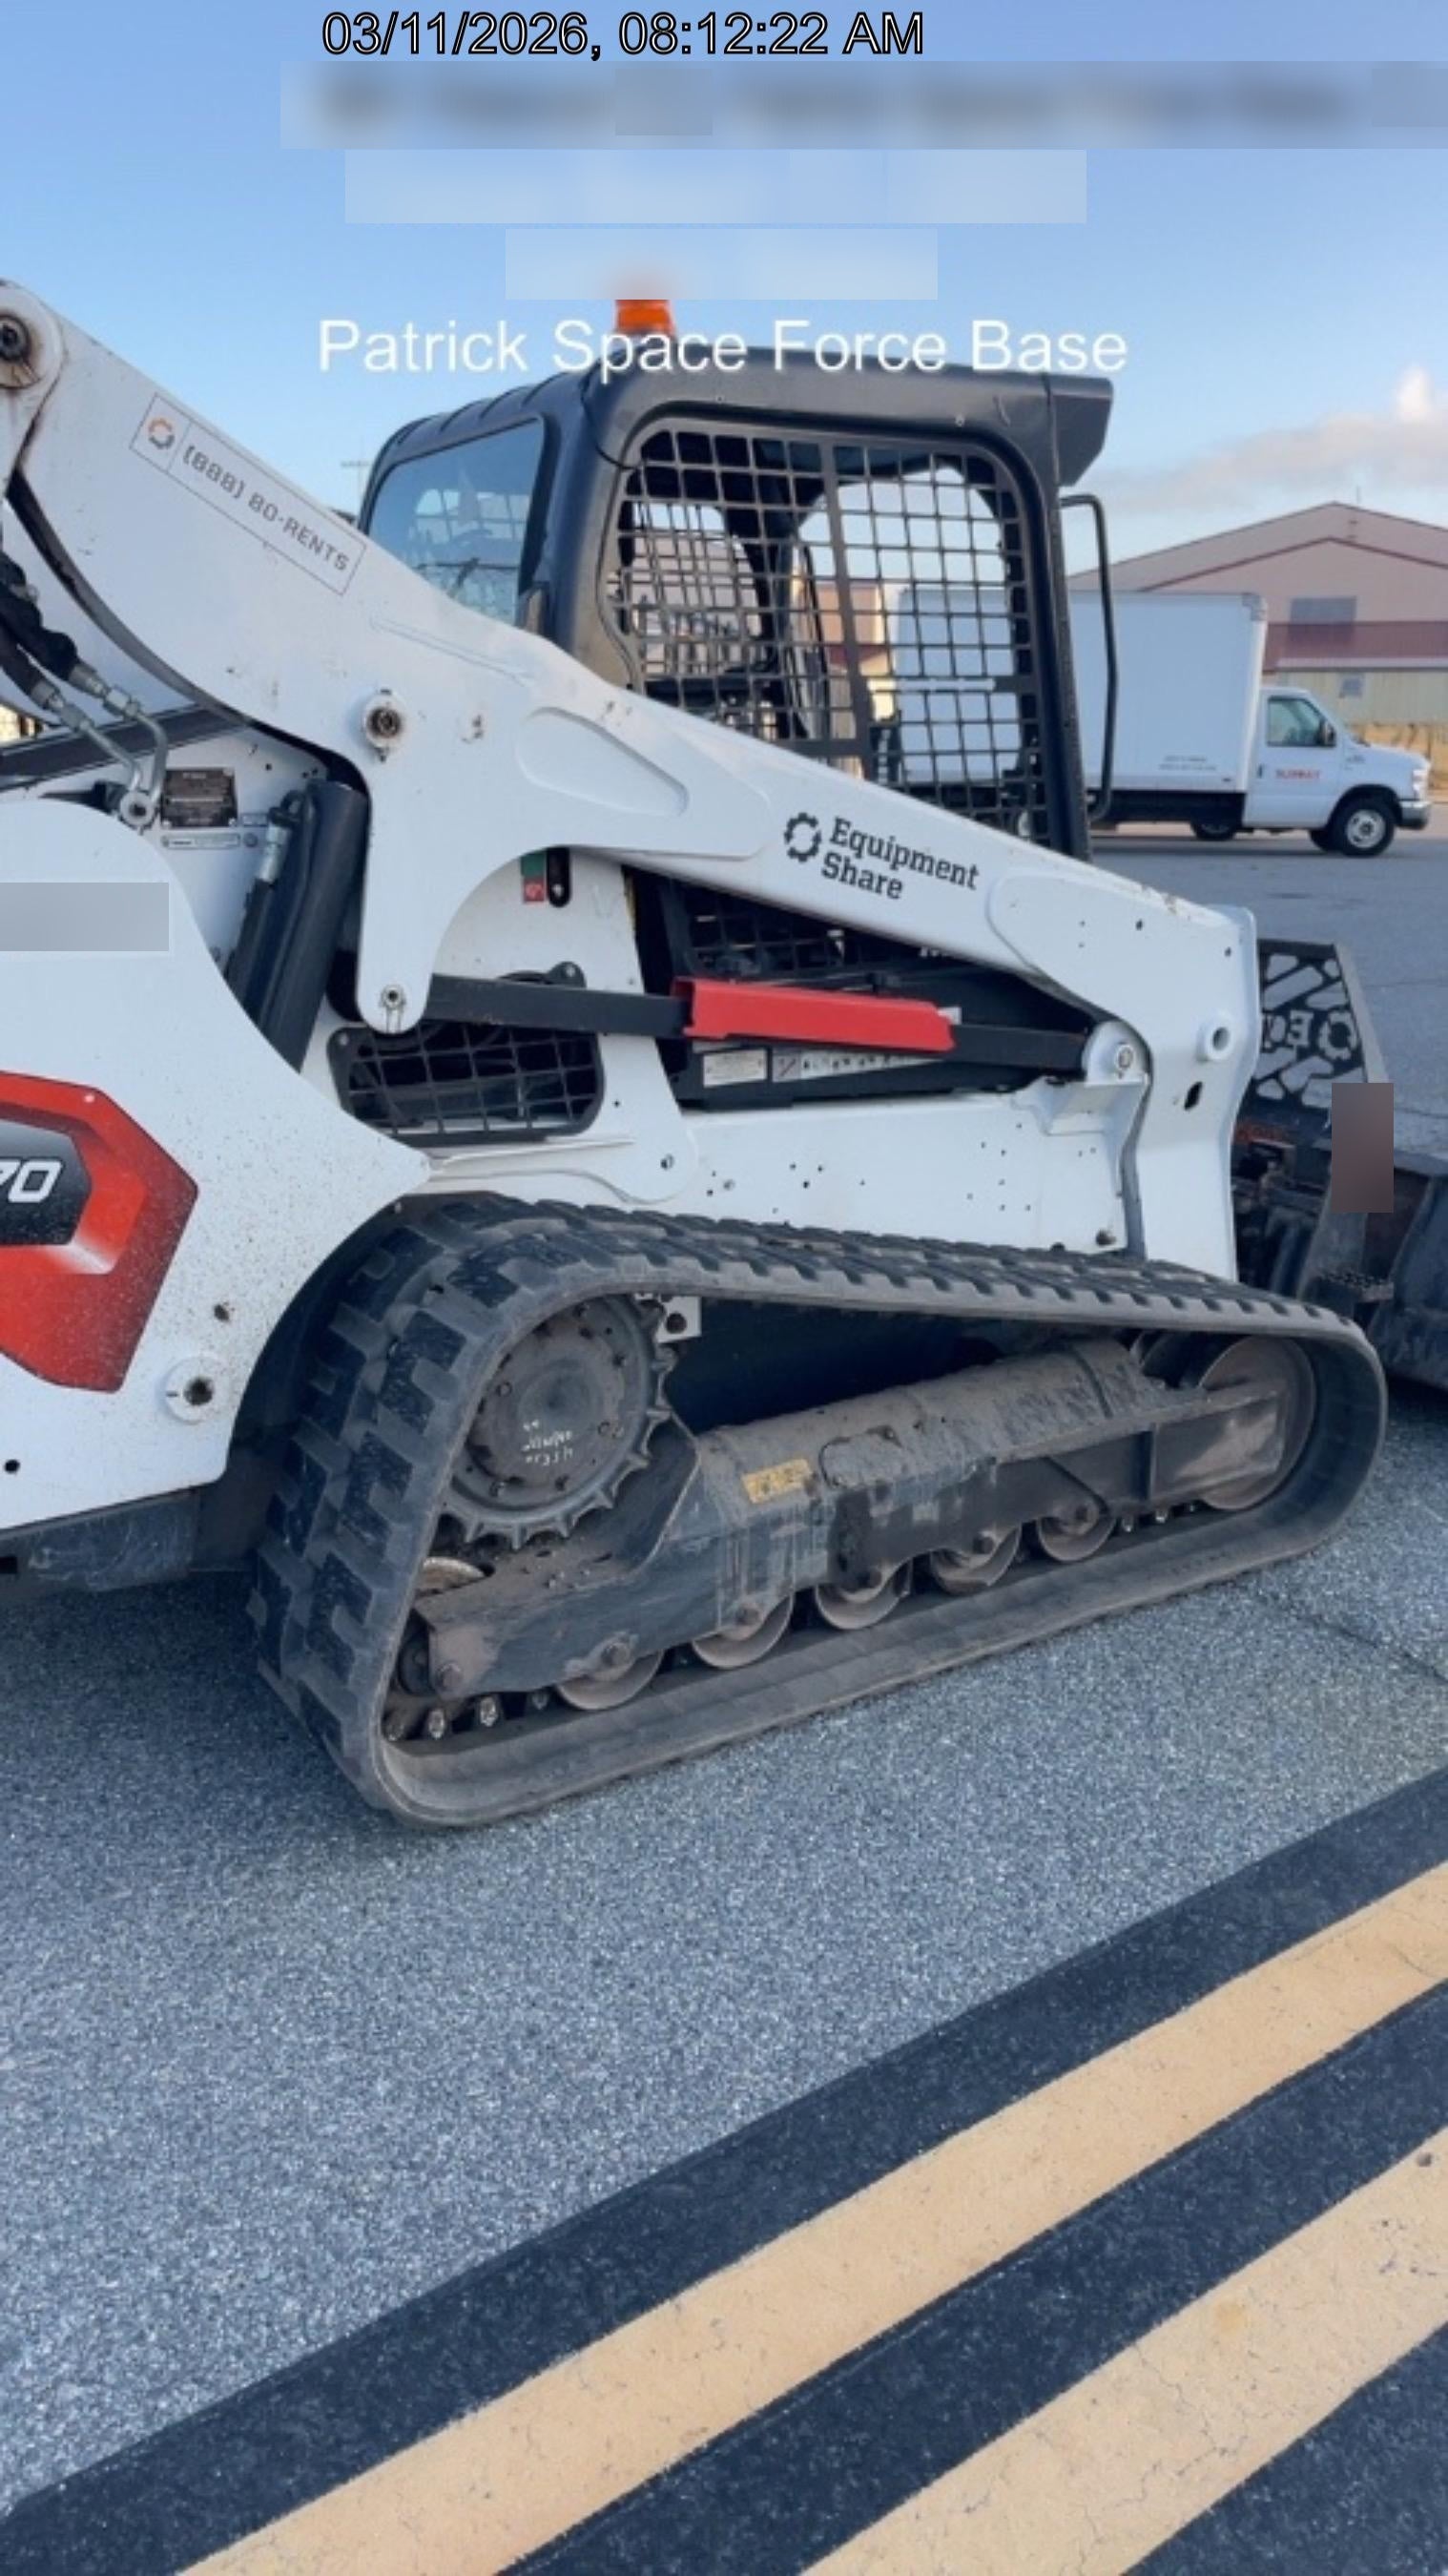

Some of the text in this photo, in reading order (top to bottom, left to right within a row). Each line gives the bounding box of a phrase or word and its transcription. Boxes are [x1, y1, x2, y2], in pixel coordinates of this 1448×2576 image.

[183, 446, 246, 499] (888)
[821, 851, 903, 900] Share
[829, 817, 980, 890] Equipment
